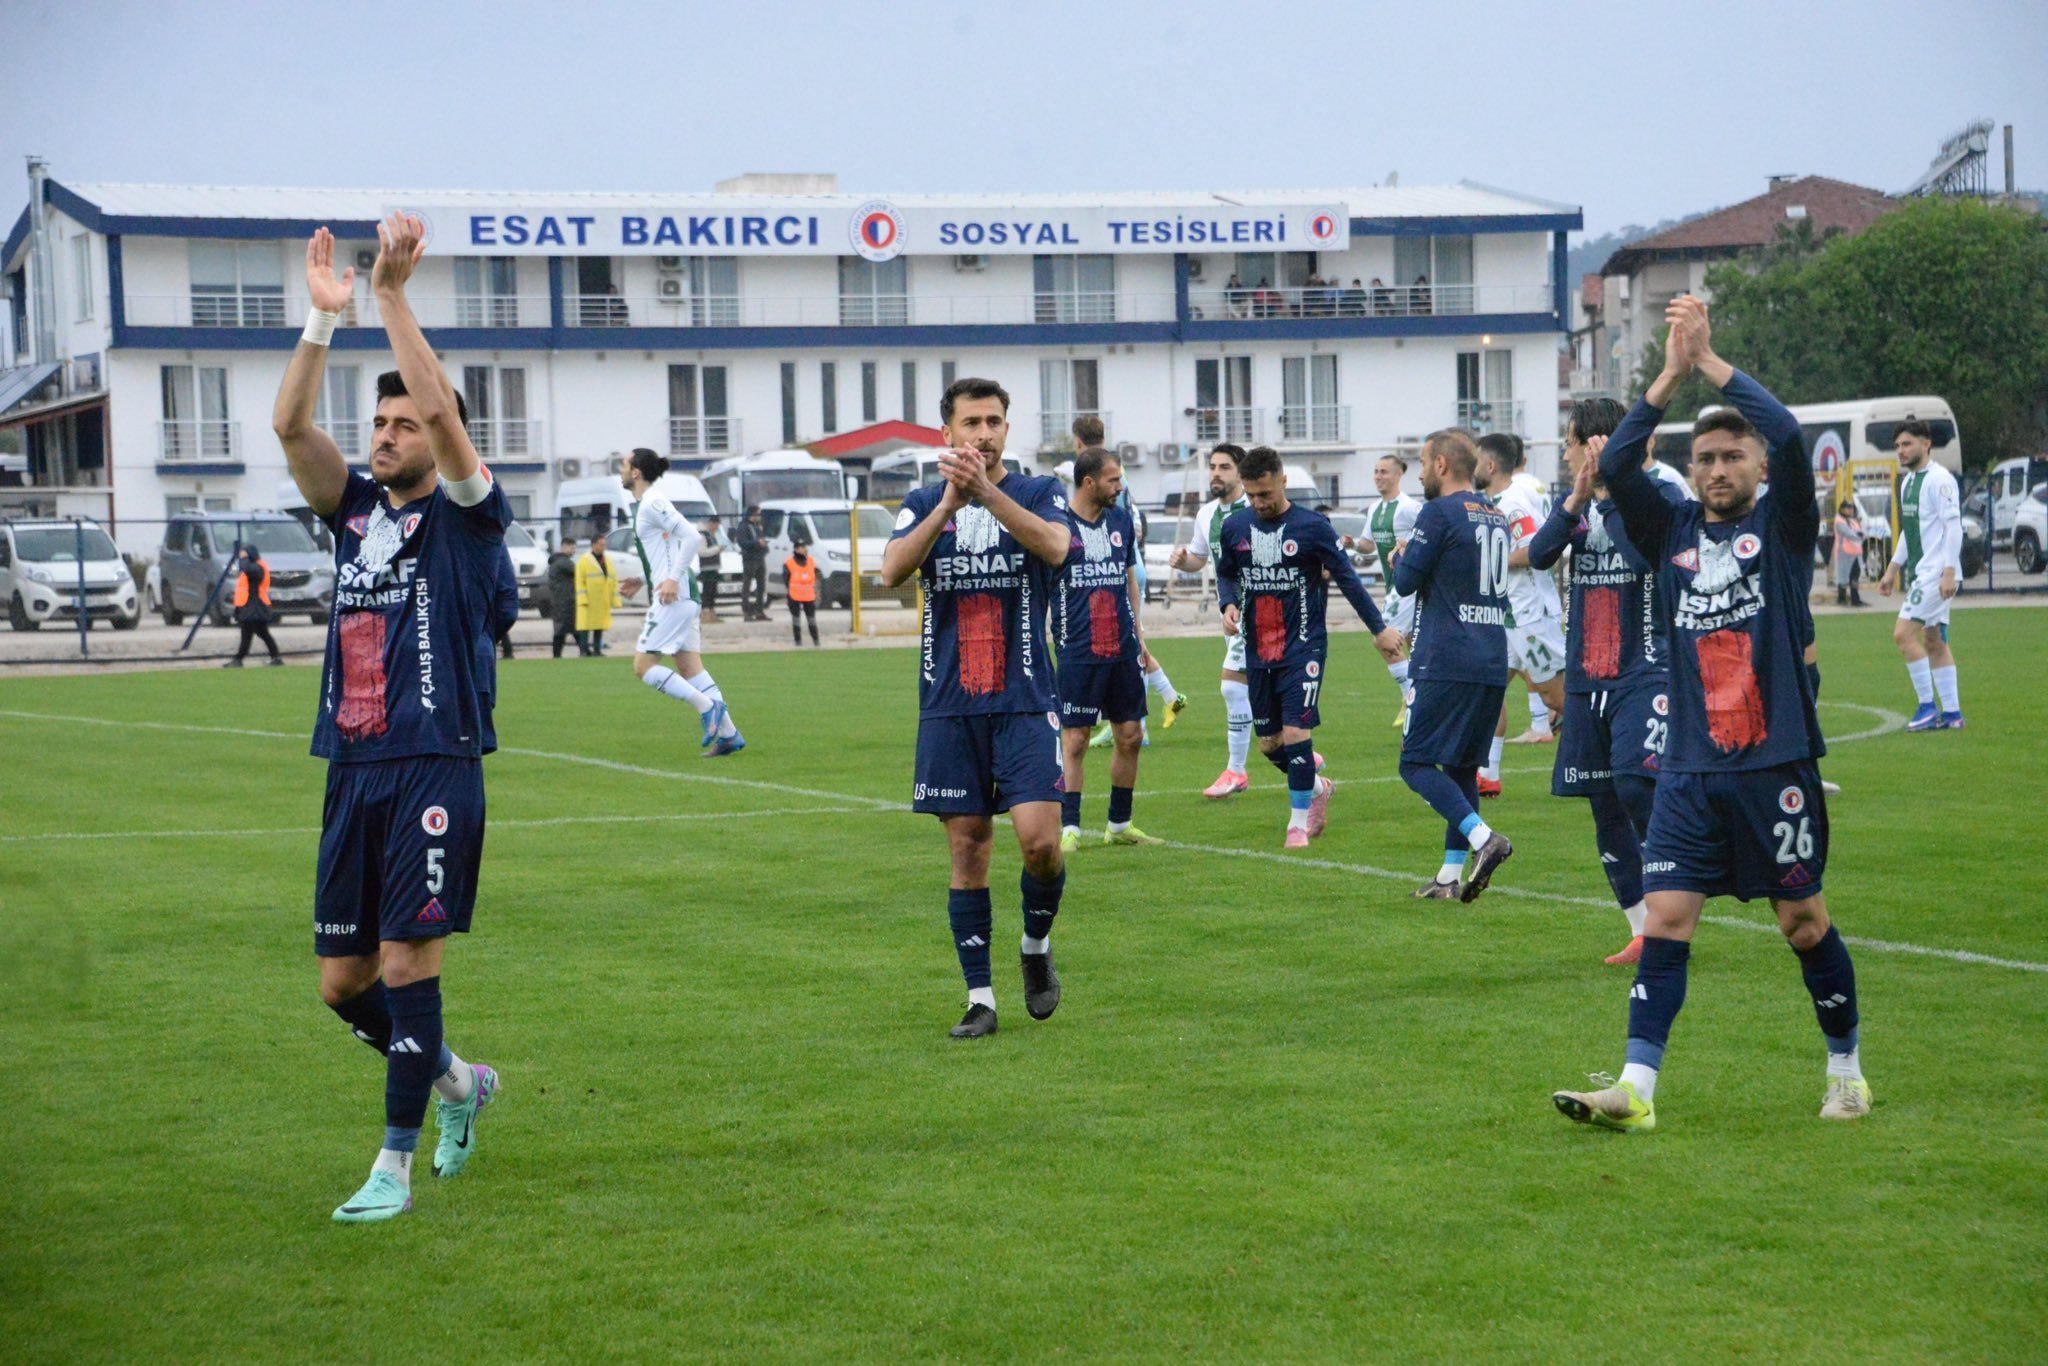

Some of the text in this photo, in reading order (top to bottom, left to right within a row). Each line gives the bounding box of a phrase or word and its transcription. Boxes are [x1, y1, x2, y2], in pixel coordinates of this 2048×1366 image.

[469, 215, 595, 246] ESAT
[621, 215, 819, 246] BAKIRCI
[939, 222, 1080, 245] SOSYAL
[1107, 214, 1286, 244] TESİSLERİ
[341, 558, 417, 589] SNAF
[935, 553, 1024, 577] ESNAF
[1071, 562, 1125, 578] ESNAF
[1242, 567, 1299, 581] ESNAF
[1475, 524, 1510, 598] 10
[933, 576, 1019, 592] HASTANES
[338, 588, 410, 607] ASTANES
[924, 578, 935, 671] ÇALIŞ BALIKÇISI
[1643, 573, 1656, 655] ÇALIŞ BALIKÇIS
[416, 578, 435, 695] ÇALIŞ BALIKÇISI
[1526, 644, 1551, 668] 11
[1303, 681, 1318, 707] 77
[1643, 717, 1668, 755] 23
[1578, 771, 1590, 779] US
[1591, 770, 1613, 779] GRU
[927, 788, 939, 797] US
[941, 788, 967, 798] GRUP
[1773, 816, 1814, 864] 26
[426, 848, 445, 894] 5
[1647, 861, 1677, 872] GRUP
[325, 923, 357, 935] GRUP
